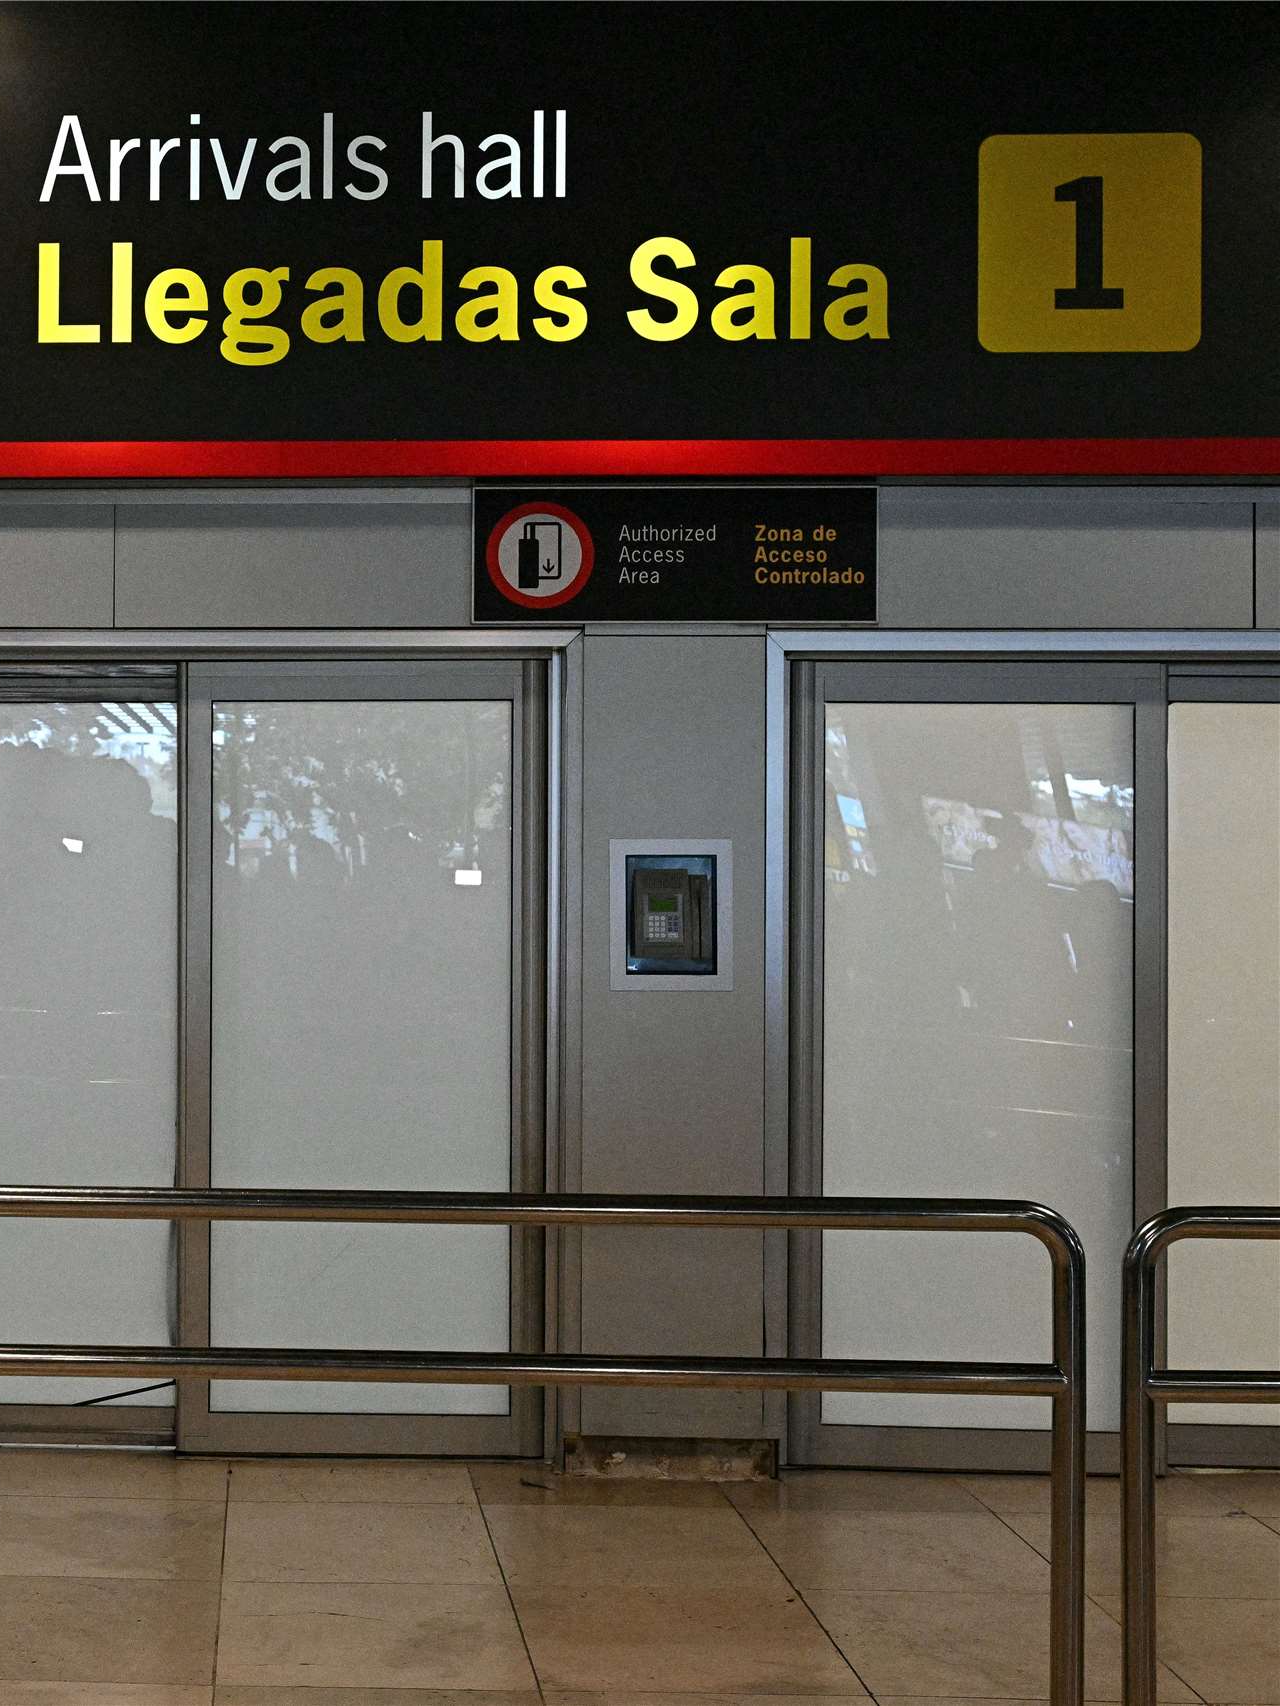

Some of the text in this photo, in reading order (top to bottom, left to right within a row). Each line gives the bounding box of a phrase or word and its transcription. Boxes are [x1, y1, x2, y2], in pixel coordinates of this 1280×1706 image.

[39, 110, 567, 202] Arrivals hall
[1054, 175, 1124, 310] 1
[38, 236, 890, 366] Llegadas Sala
[618, 524, 717, 542] Authorized
[754, 525, 838, 543] Zona de
[618, 545, 686, 563] Access
[754, 546, 829, 563] Acceso
[618, 566, 661, 584] Area
[754, 566, 866, 584] Controlado
